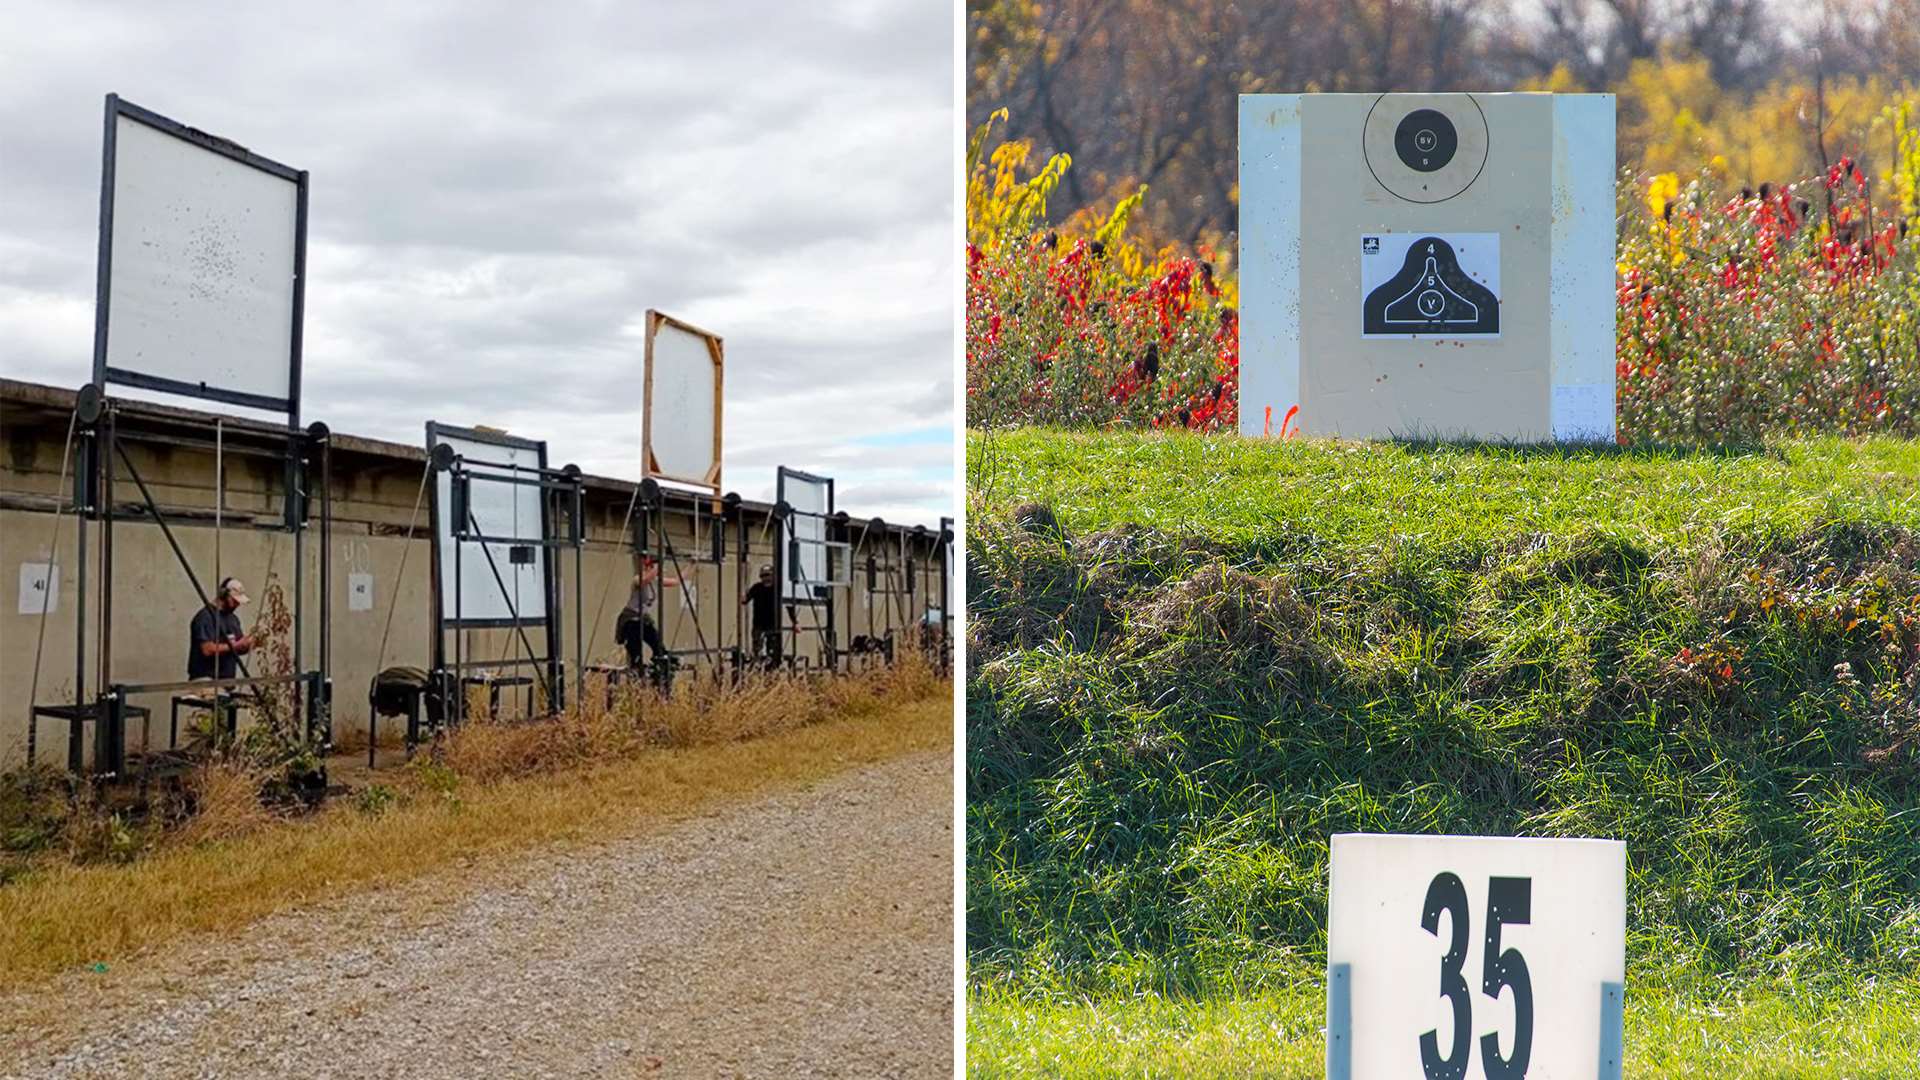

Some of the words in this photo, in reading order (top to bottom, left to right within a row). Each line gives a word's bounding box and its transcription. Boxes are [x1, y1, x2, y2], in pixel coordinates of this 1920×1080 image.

[1422, 184, 1428, 192] 4
[1427, 243, 1435, 254] 4
[1427, 276, 1435, 286] 5
[1427, 299, 1436, 310] V
[1419, 871, 1534, 1080] 35
